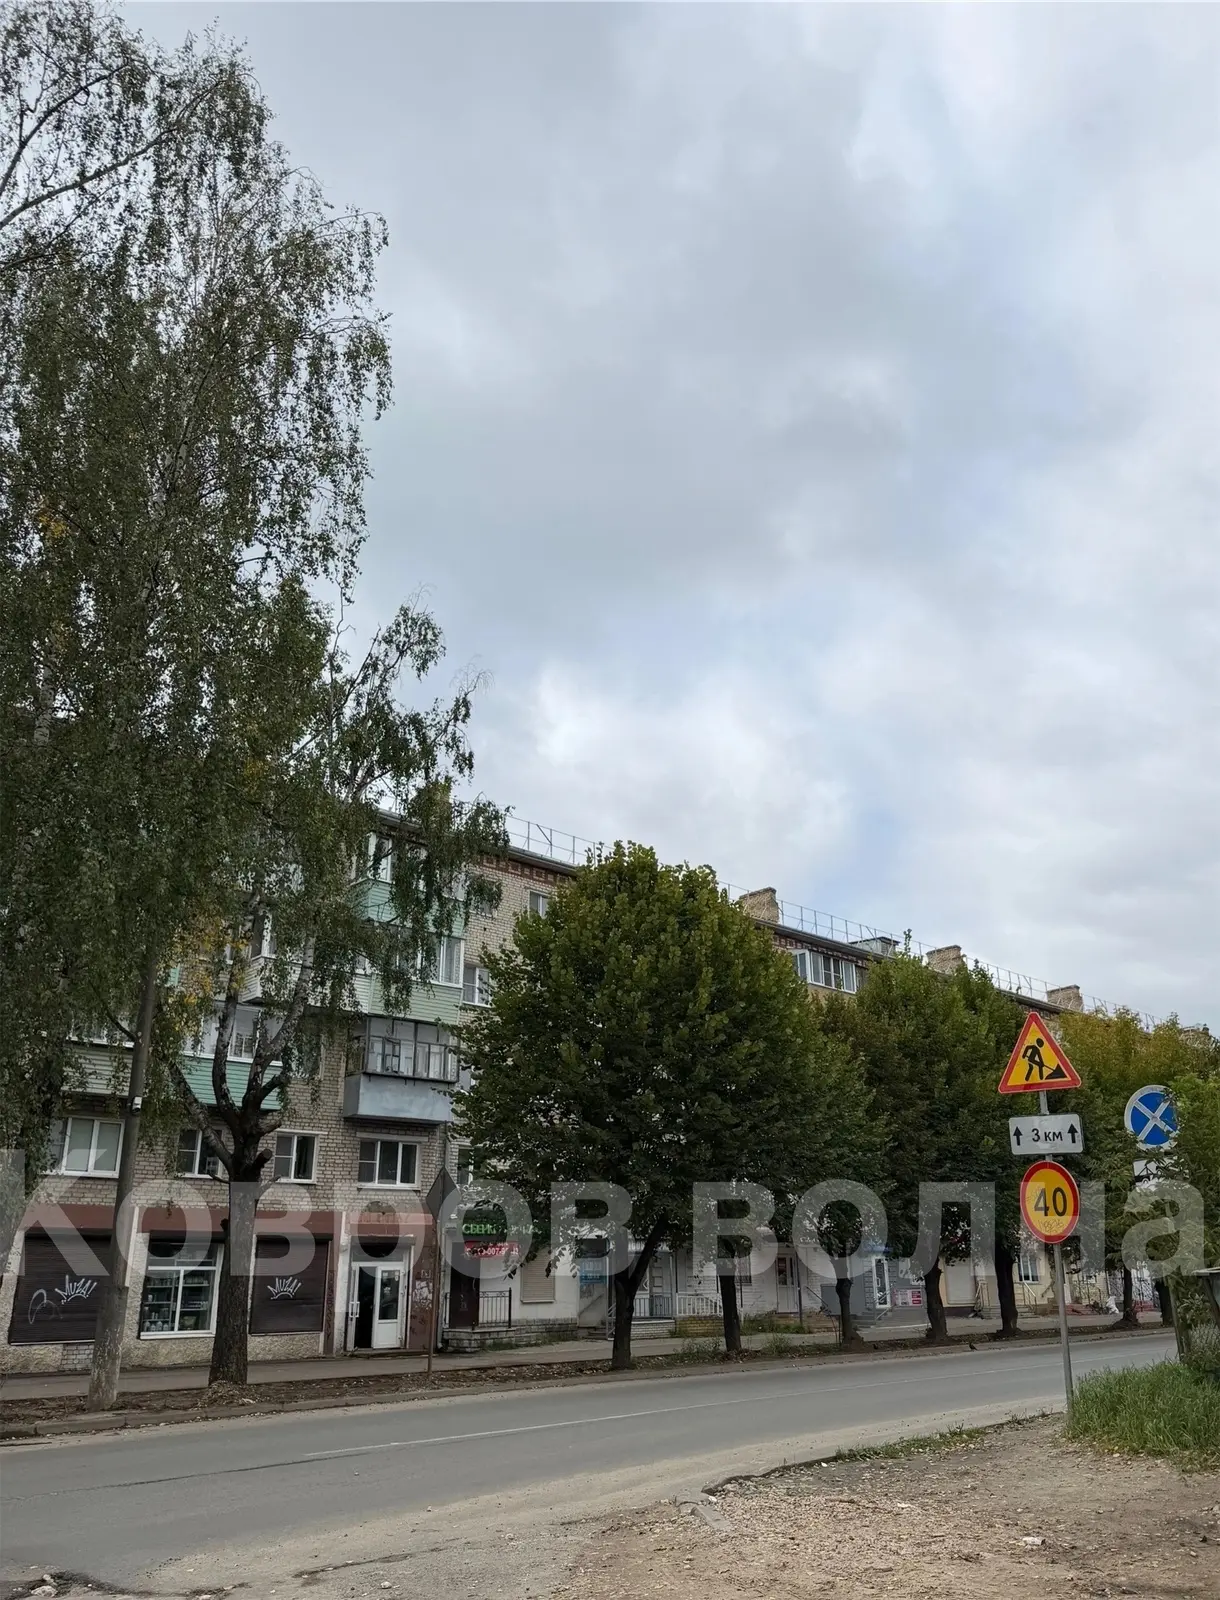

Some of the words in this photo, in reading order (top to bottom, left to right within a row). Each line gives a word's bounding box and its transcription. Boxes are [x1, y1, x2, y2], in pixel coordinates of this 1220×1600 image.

[1031, 1127, 1041, 1143] 3
[1043, 1130, 1064, 1142] км
[1033, 1186, 1068, 1218] 40
